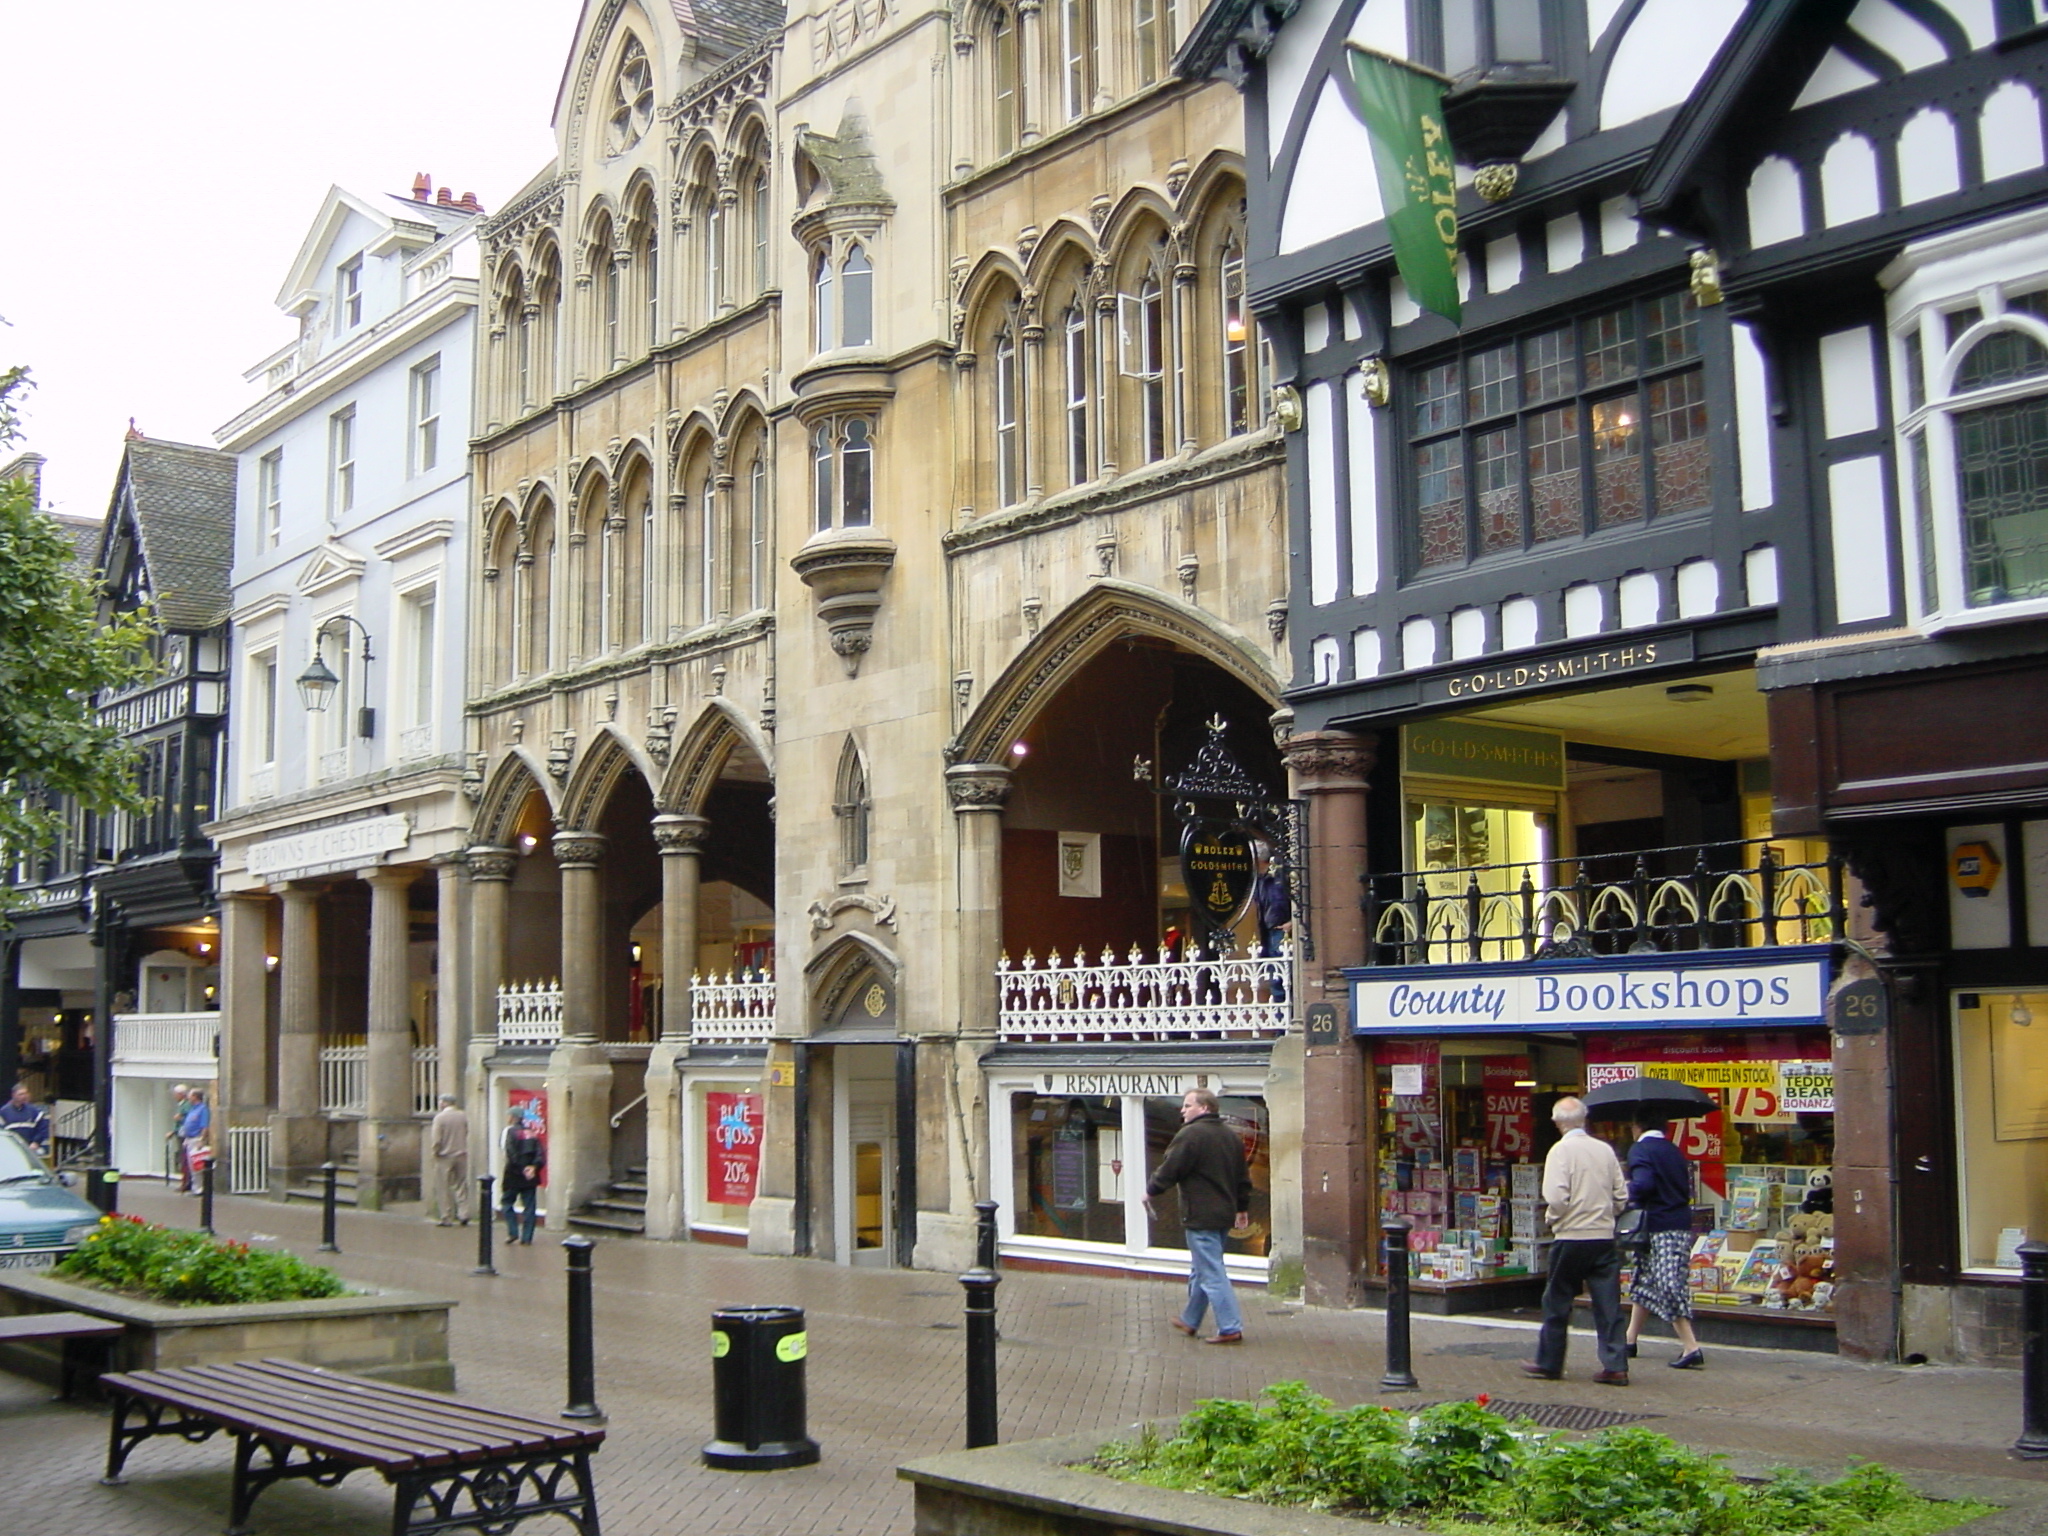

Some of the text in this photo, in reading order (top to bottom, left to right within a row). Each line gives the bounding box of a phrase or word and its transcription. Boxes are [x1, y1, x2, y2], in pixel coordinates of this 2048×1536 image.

[323, 822, 386, 856] CHESTER
[1204, 844, 1236, 855] ROLEX
[1190, 860, 1249, 872] GOLDSMITHS
[1388, 970, 1792, 1021] County Bookshops
[1846, 994, 1878, 1017] 26
[1312, 1013, 1333, 1032] 26
[1591, 1067, 1635, 1078] BACK TO
[1650, 1068, 1669, 1080] OVER
[1688, 1068, 1705, 1083] NEW
[1706, 1067, 1732, 1083] TITLES
[1733, 1068, 1741, 1082] IN
[1743, 1068, 1770, 1083] STOCK
[1785, 1076, 1833, 1087] TEDDY
[1065, 1074, 1184, 1095] RESTAURANT
[1786, 1087, 1834, 1098] BEAR
[720, 1103, 751, 1123] BLUE
[1486, 1095, 1530, 1113] SAVE
[716, 1125, 756, 1145] CROSS
[724, 1161, 750, 1183] 20%
